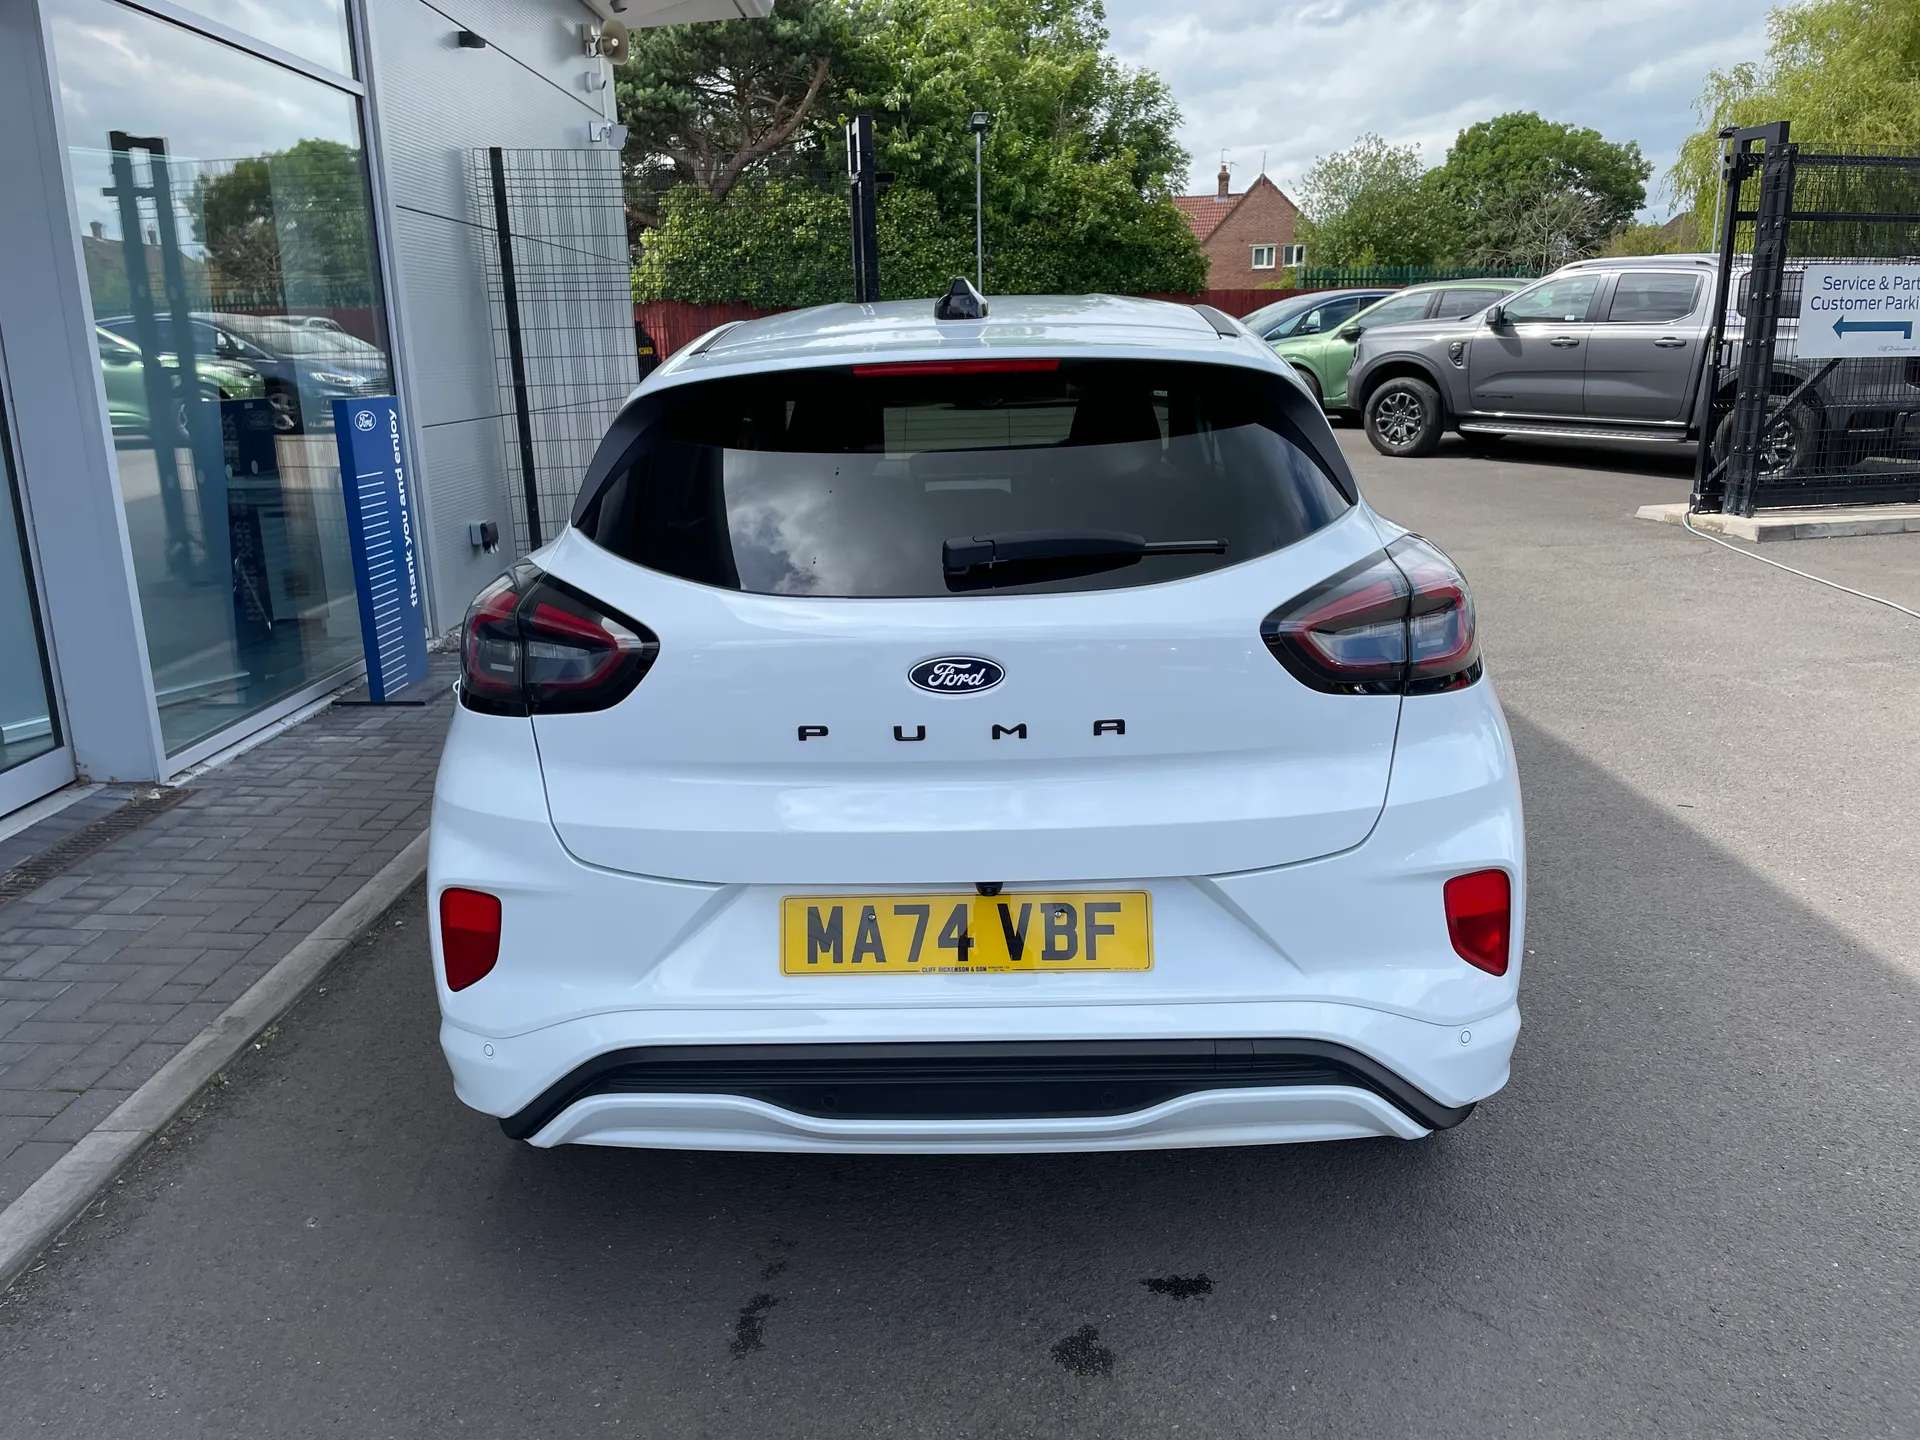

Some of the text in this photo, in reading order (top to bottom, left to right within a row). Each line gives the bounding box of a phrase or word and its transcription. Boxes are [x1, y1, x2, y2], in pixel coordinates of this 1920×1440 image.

[1822, 276, 1876, 290] Service
[1879, 275, 1889, 290] &
[1810, 296, 1882, 311] Customer
[388, 408, 418, 607] thank you and enjoy
[928, 662, 985, 687] Ford
[797, 719, 1126, 741] PUMA
[807, 902, 1122, 964] MA74 VBF
